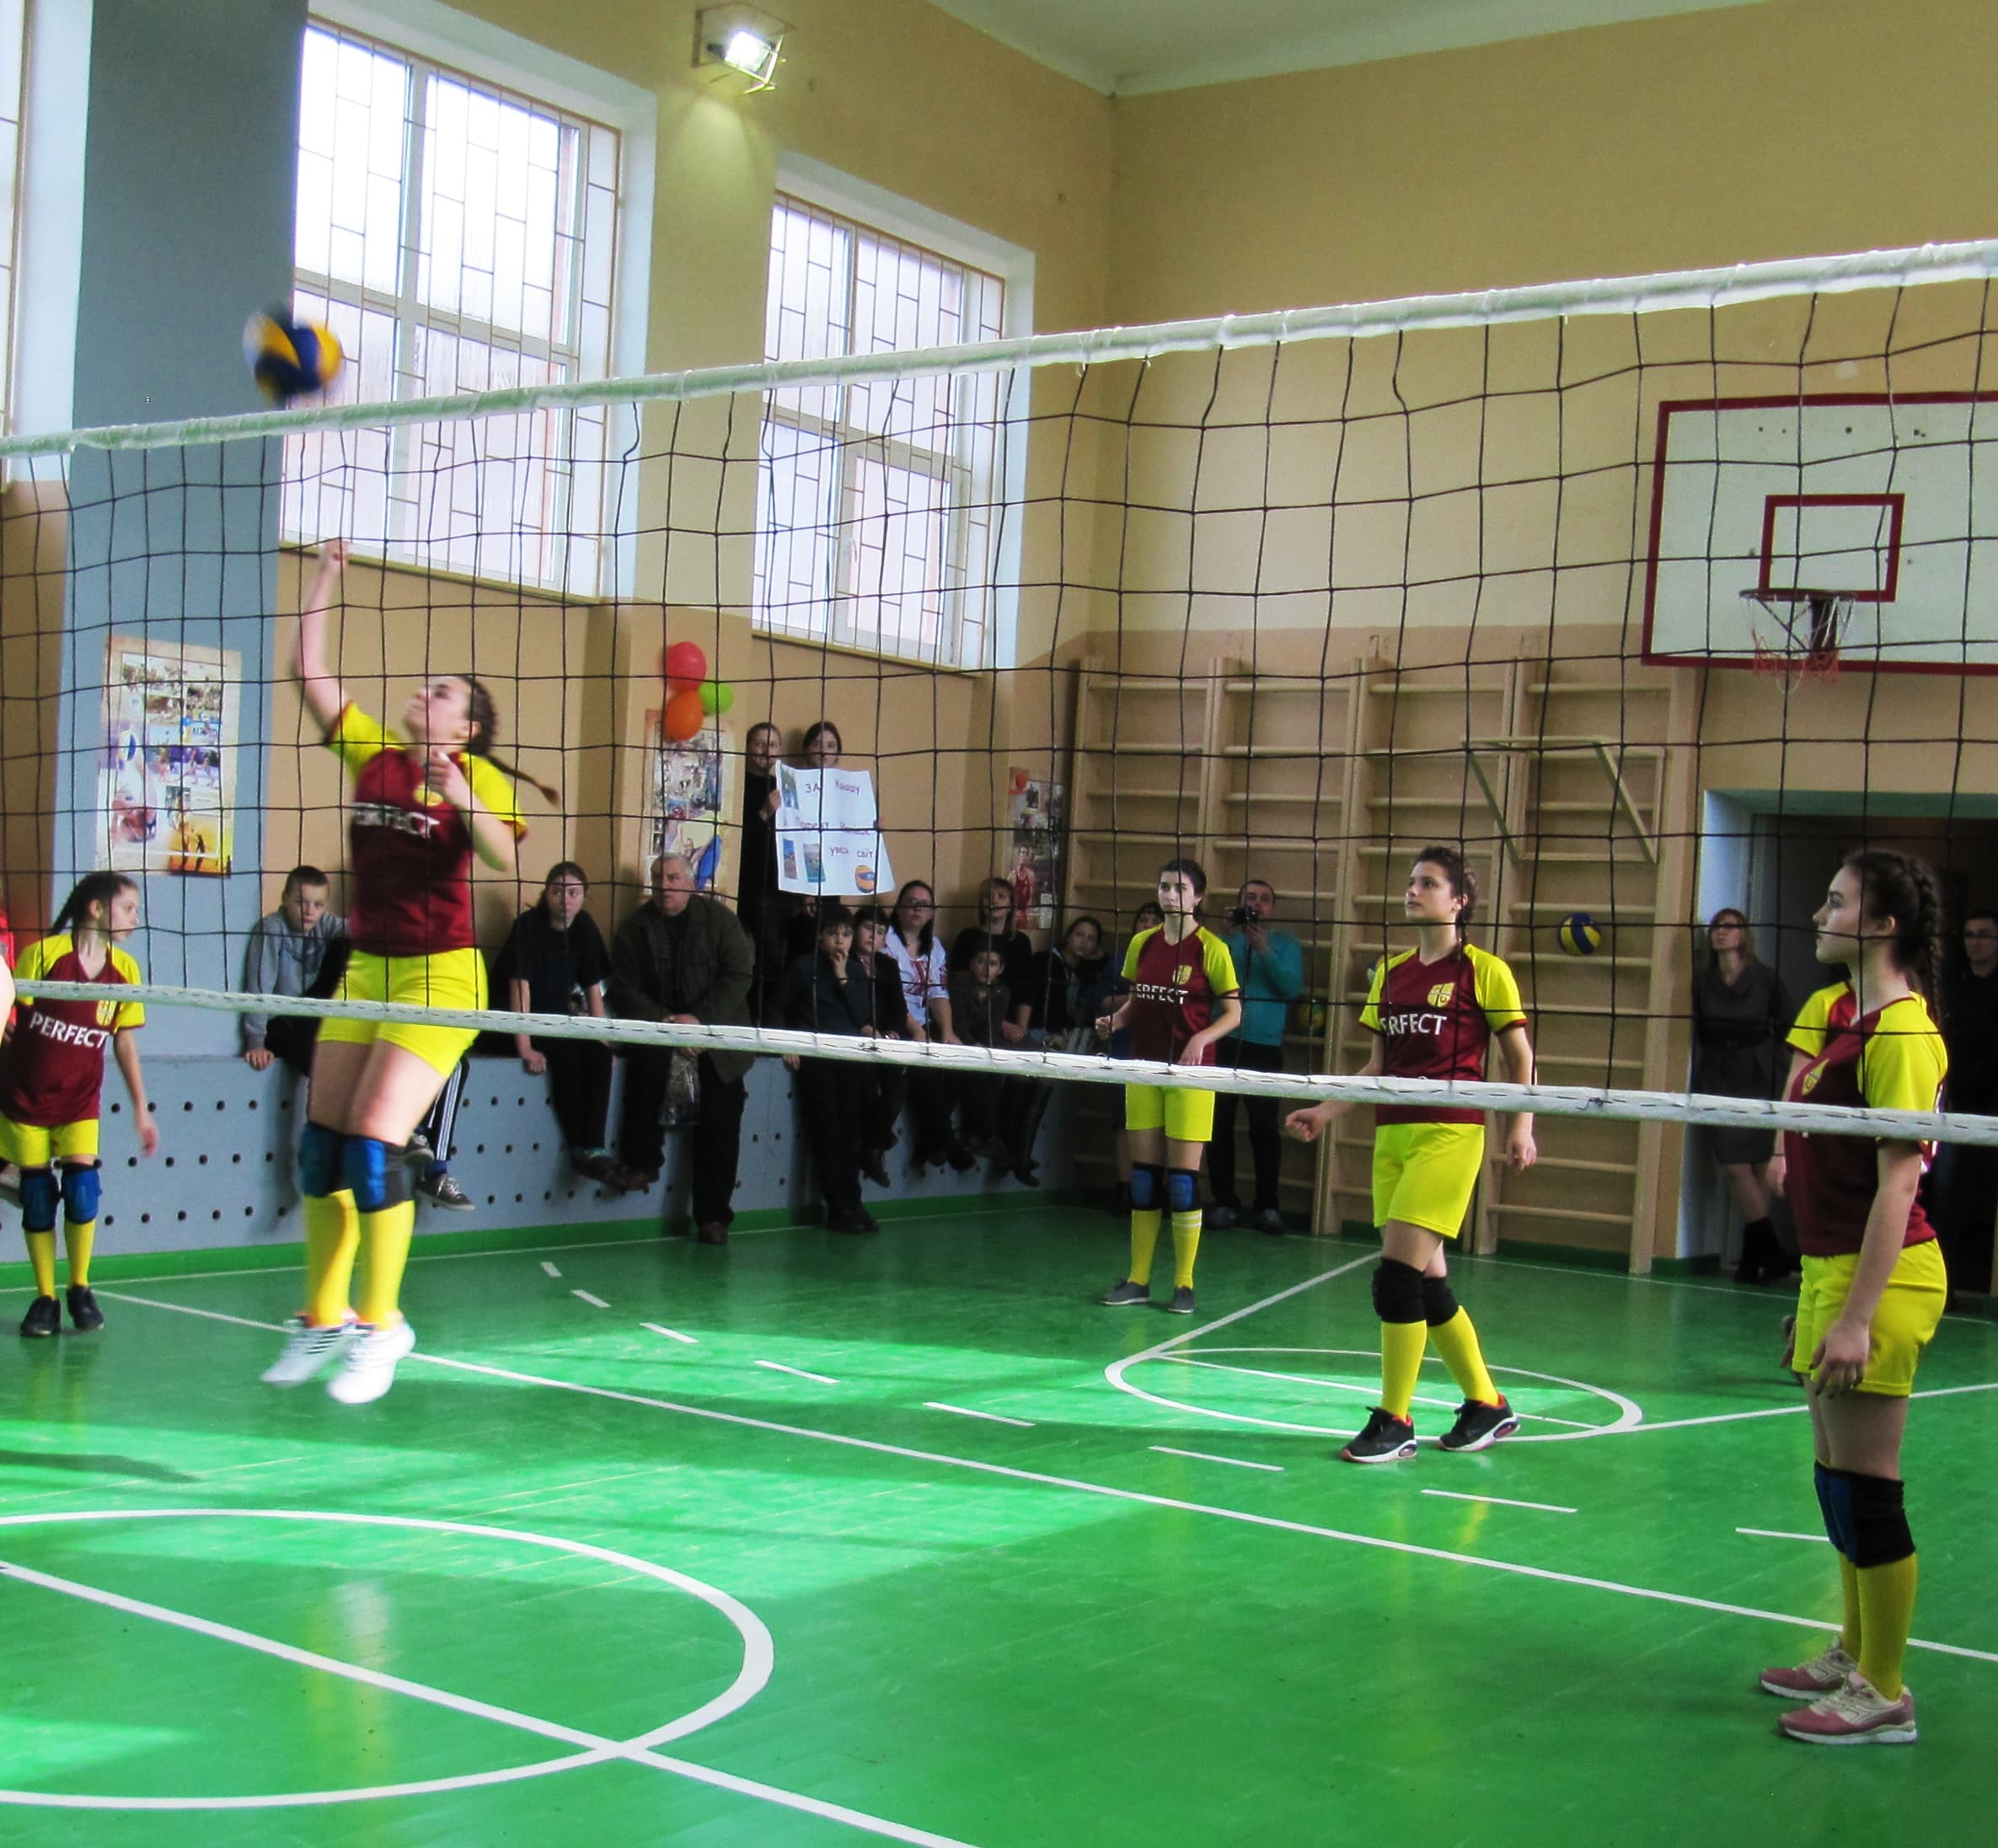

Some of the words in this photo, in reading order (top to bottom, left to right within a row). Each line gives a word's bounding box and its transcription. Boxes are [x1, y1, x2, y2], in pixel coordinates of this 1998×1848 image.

[1135, 983, 1188, 1004] ERFECT
[29, 1011, 110, 1049] PERFECT
[1379, 1013, 1447, 1036] ERFECT
